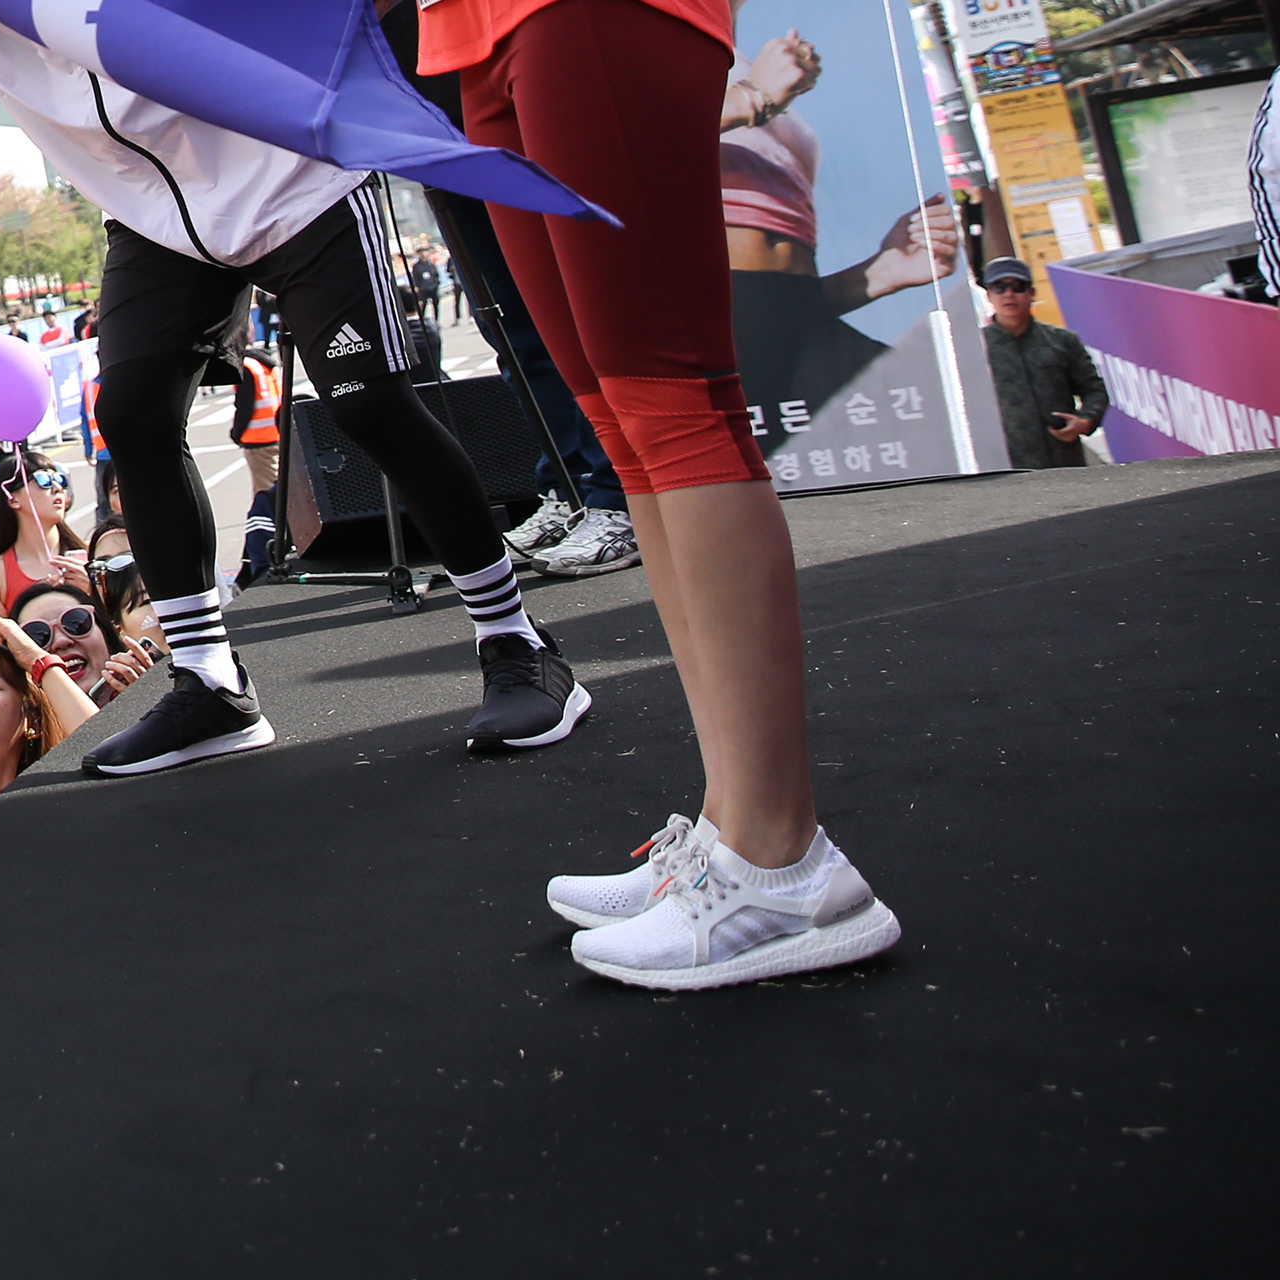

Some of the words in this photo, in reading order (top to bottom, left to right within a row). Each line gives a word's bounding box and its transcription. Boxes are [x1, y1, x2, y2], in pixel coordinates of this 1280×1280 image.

[326, 341, 371, 358] adidas
[331, 382, 365, 398] adidas
[845, 386, 924, 426] 순간
[772, 441, 909, 481] 경험하라
